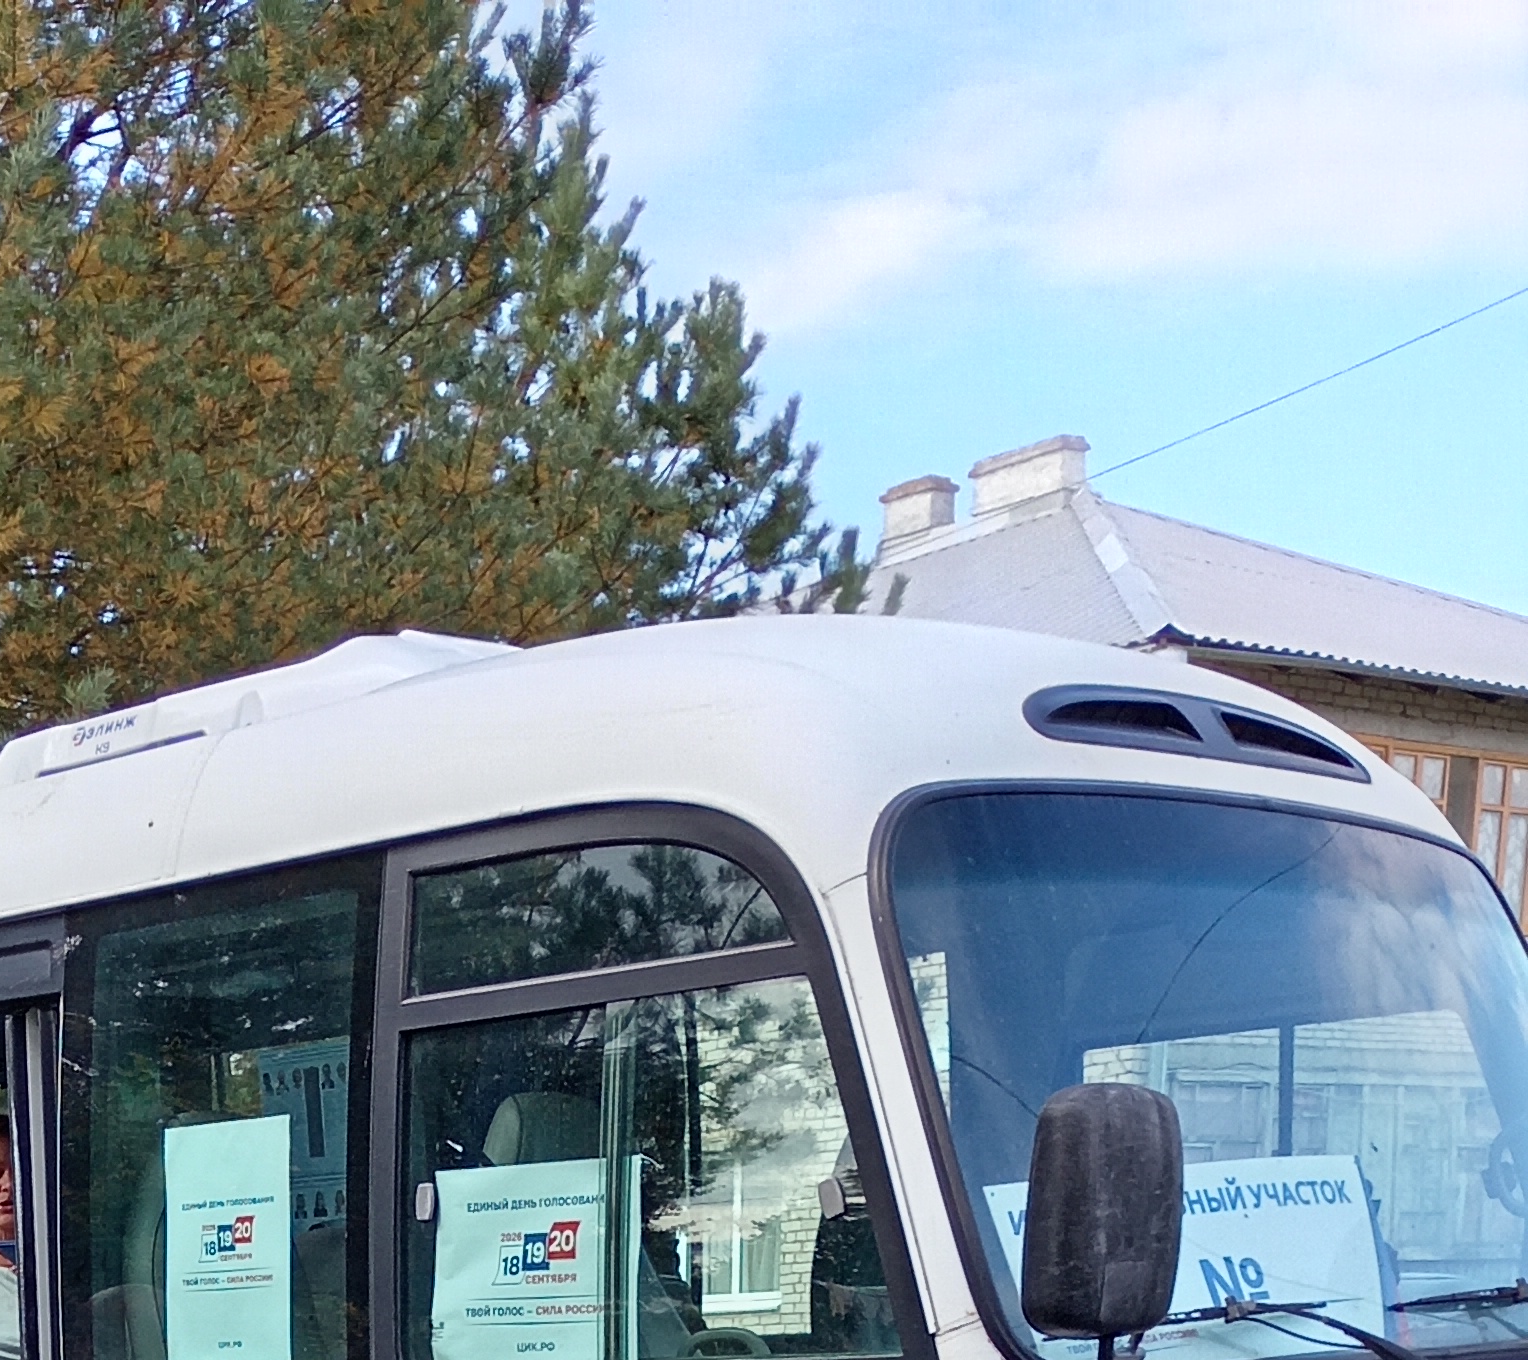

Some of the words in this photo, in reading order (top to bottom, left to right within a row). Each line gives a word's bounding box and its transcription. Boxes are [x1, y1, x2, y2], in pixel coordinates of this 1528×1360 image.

[467, 1199, 509, 1213] ЕДИНЫЙ
[511, 1198, 537, 1210] ДЕНЬ
[539, 1194, 605, 1208] ГОЛОСОВАНИ
[1246, 1180, 1352, 1208] УЧАСТОК
[204, 1241, 216, 1255] 18
[219, 1230, 232, 1248] 19
[234, 1221, 251, 1239] 20
[502, 1256, 520, 1276] 18
[525, 1242, 545, 1264] 19
[549, 1229, 574, 1252] 20
[525, 1273, 577, 1285] СЕНТЯБРЯ
[466, 1305, 490, 1317] ТВОЙ
[492, 1306, 524, 1316] ГОЛОС
[536, 1305, 563, 1316] СИЛА
[517, 1343, 555, 1353] ЦИК.РФ
